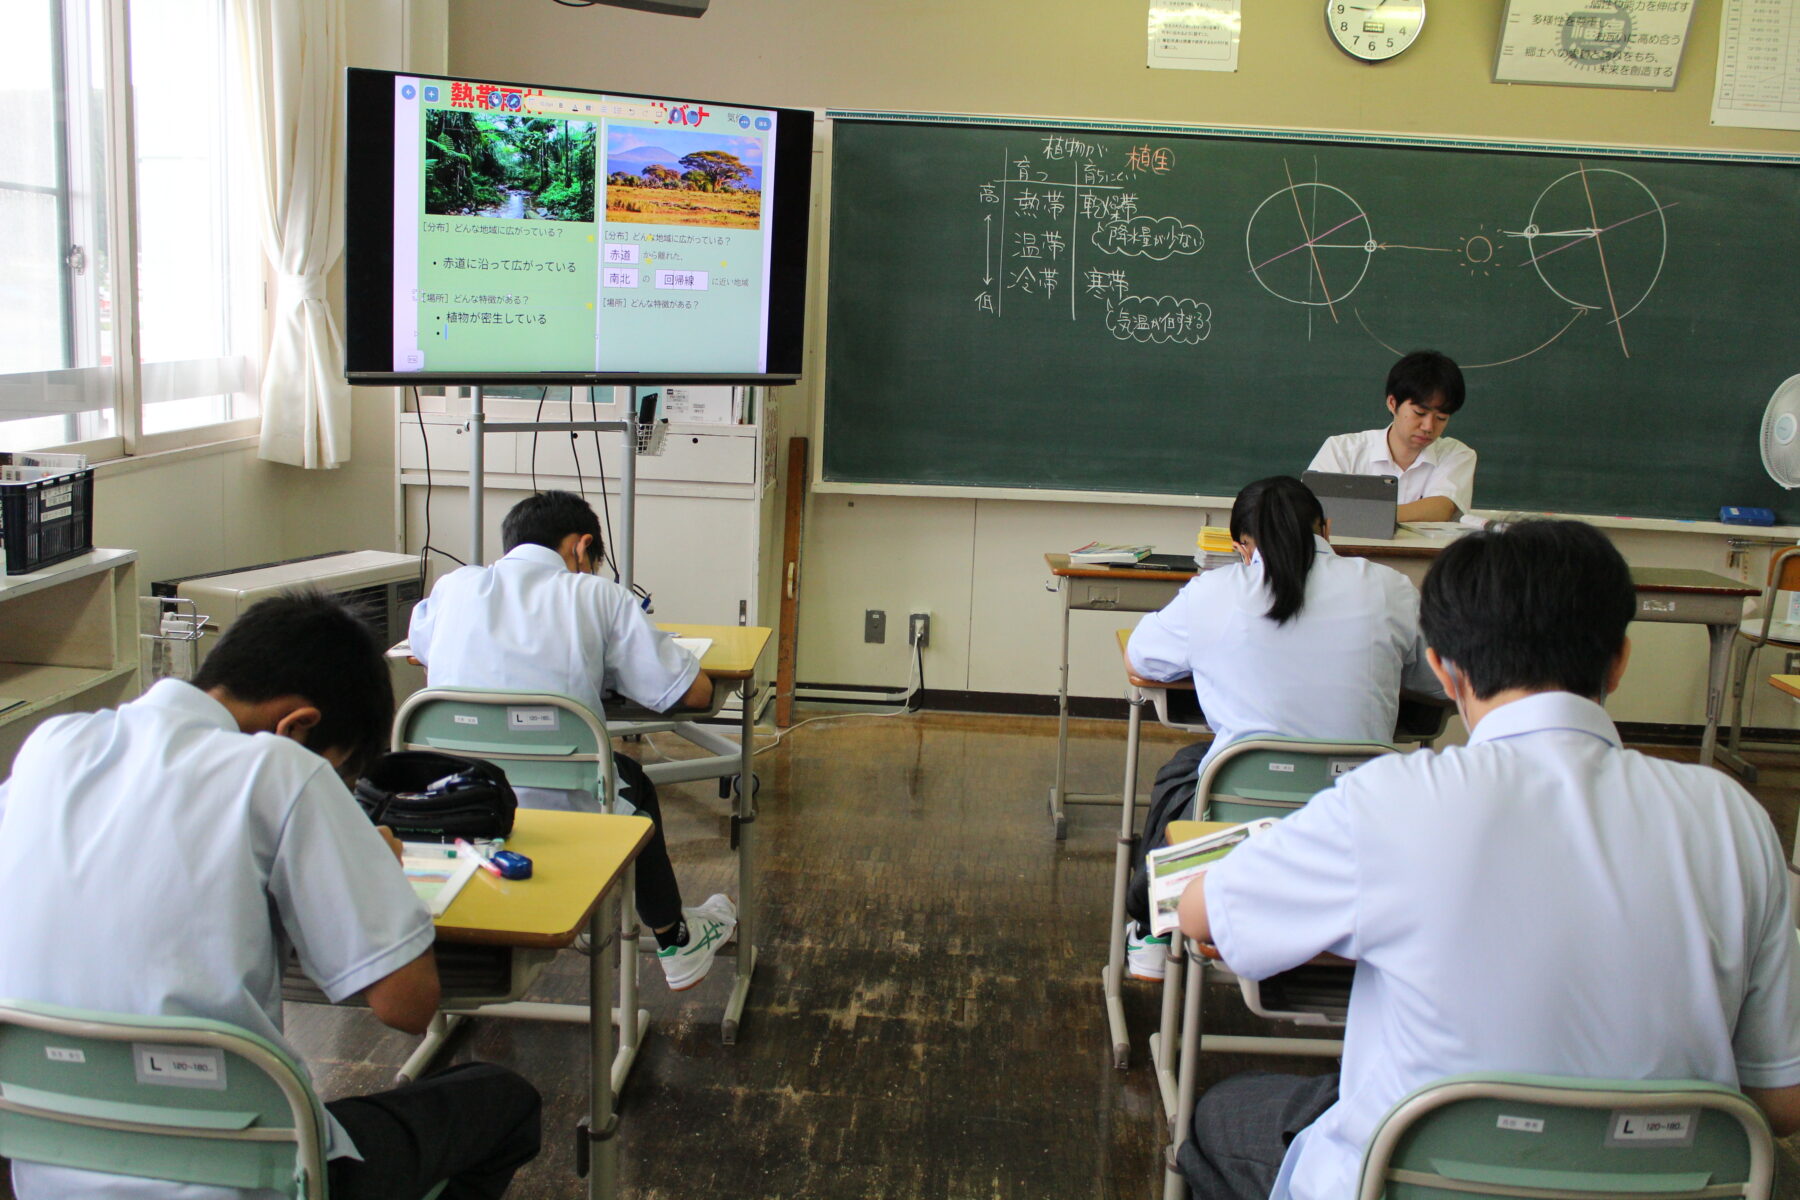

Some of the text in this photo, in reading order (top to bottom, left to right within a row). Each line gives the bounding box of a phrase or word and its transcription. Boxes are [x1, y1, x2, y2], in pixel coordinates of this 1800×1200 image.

[1337, 4, 1345, 15] 9
[1340, 21, 1348, 32] 8
[1399, 27, 1406, 36] 4
[1352, 35, 1360, 46] 7
[1368, 41, 1376, 51] 6
[1386, 38, 1394, 48] 5
[1041, 134, 1108, 160] 植物が
[1125, 144, 1172, 174] 植生
[1013, 155, 1049, 182] 育つ
[979, 182, 999, 204] 高
[1013, 188, 1066, 221] 熱帯
[1080, 189, 1139, 222] 乾燥帯
[1109, 225, 1202, 249] 降水量が少ない
[1012, 231, 1066, 261] 温帯
[610, 249, 631, 262] 赤道
[443, 257, 577, 273] 赤道に沿って広がっている
[609, 273, 631, 286] 南北
[642, 275, 650, 283] の
[664, 274, 695, 287] 回帰線
[1007, 266, 1060, 300] 冷帯
[1084, 267, 1130, 300] 寒帯
[974, 291, 994, 314] 低
[446, 311, 548, 325] 植物が密生している
[1117, 307, 1204, 336] 気温が低すぎる
[516, 714, 523, 723] L
[1335, 764, 1342, 773] L
[150, 1056, 162, 1071] L
[1623, 1119, 1635, 1134] L
